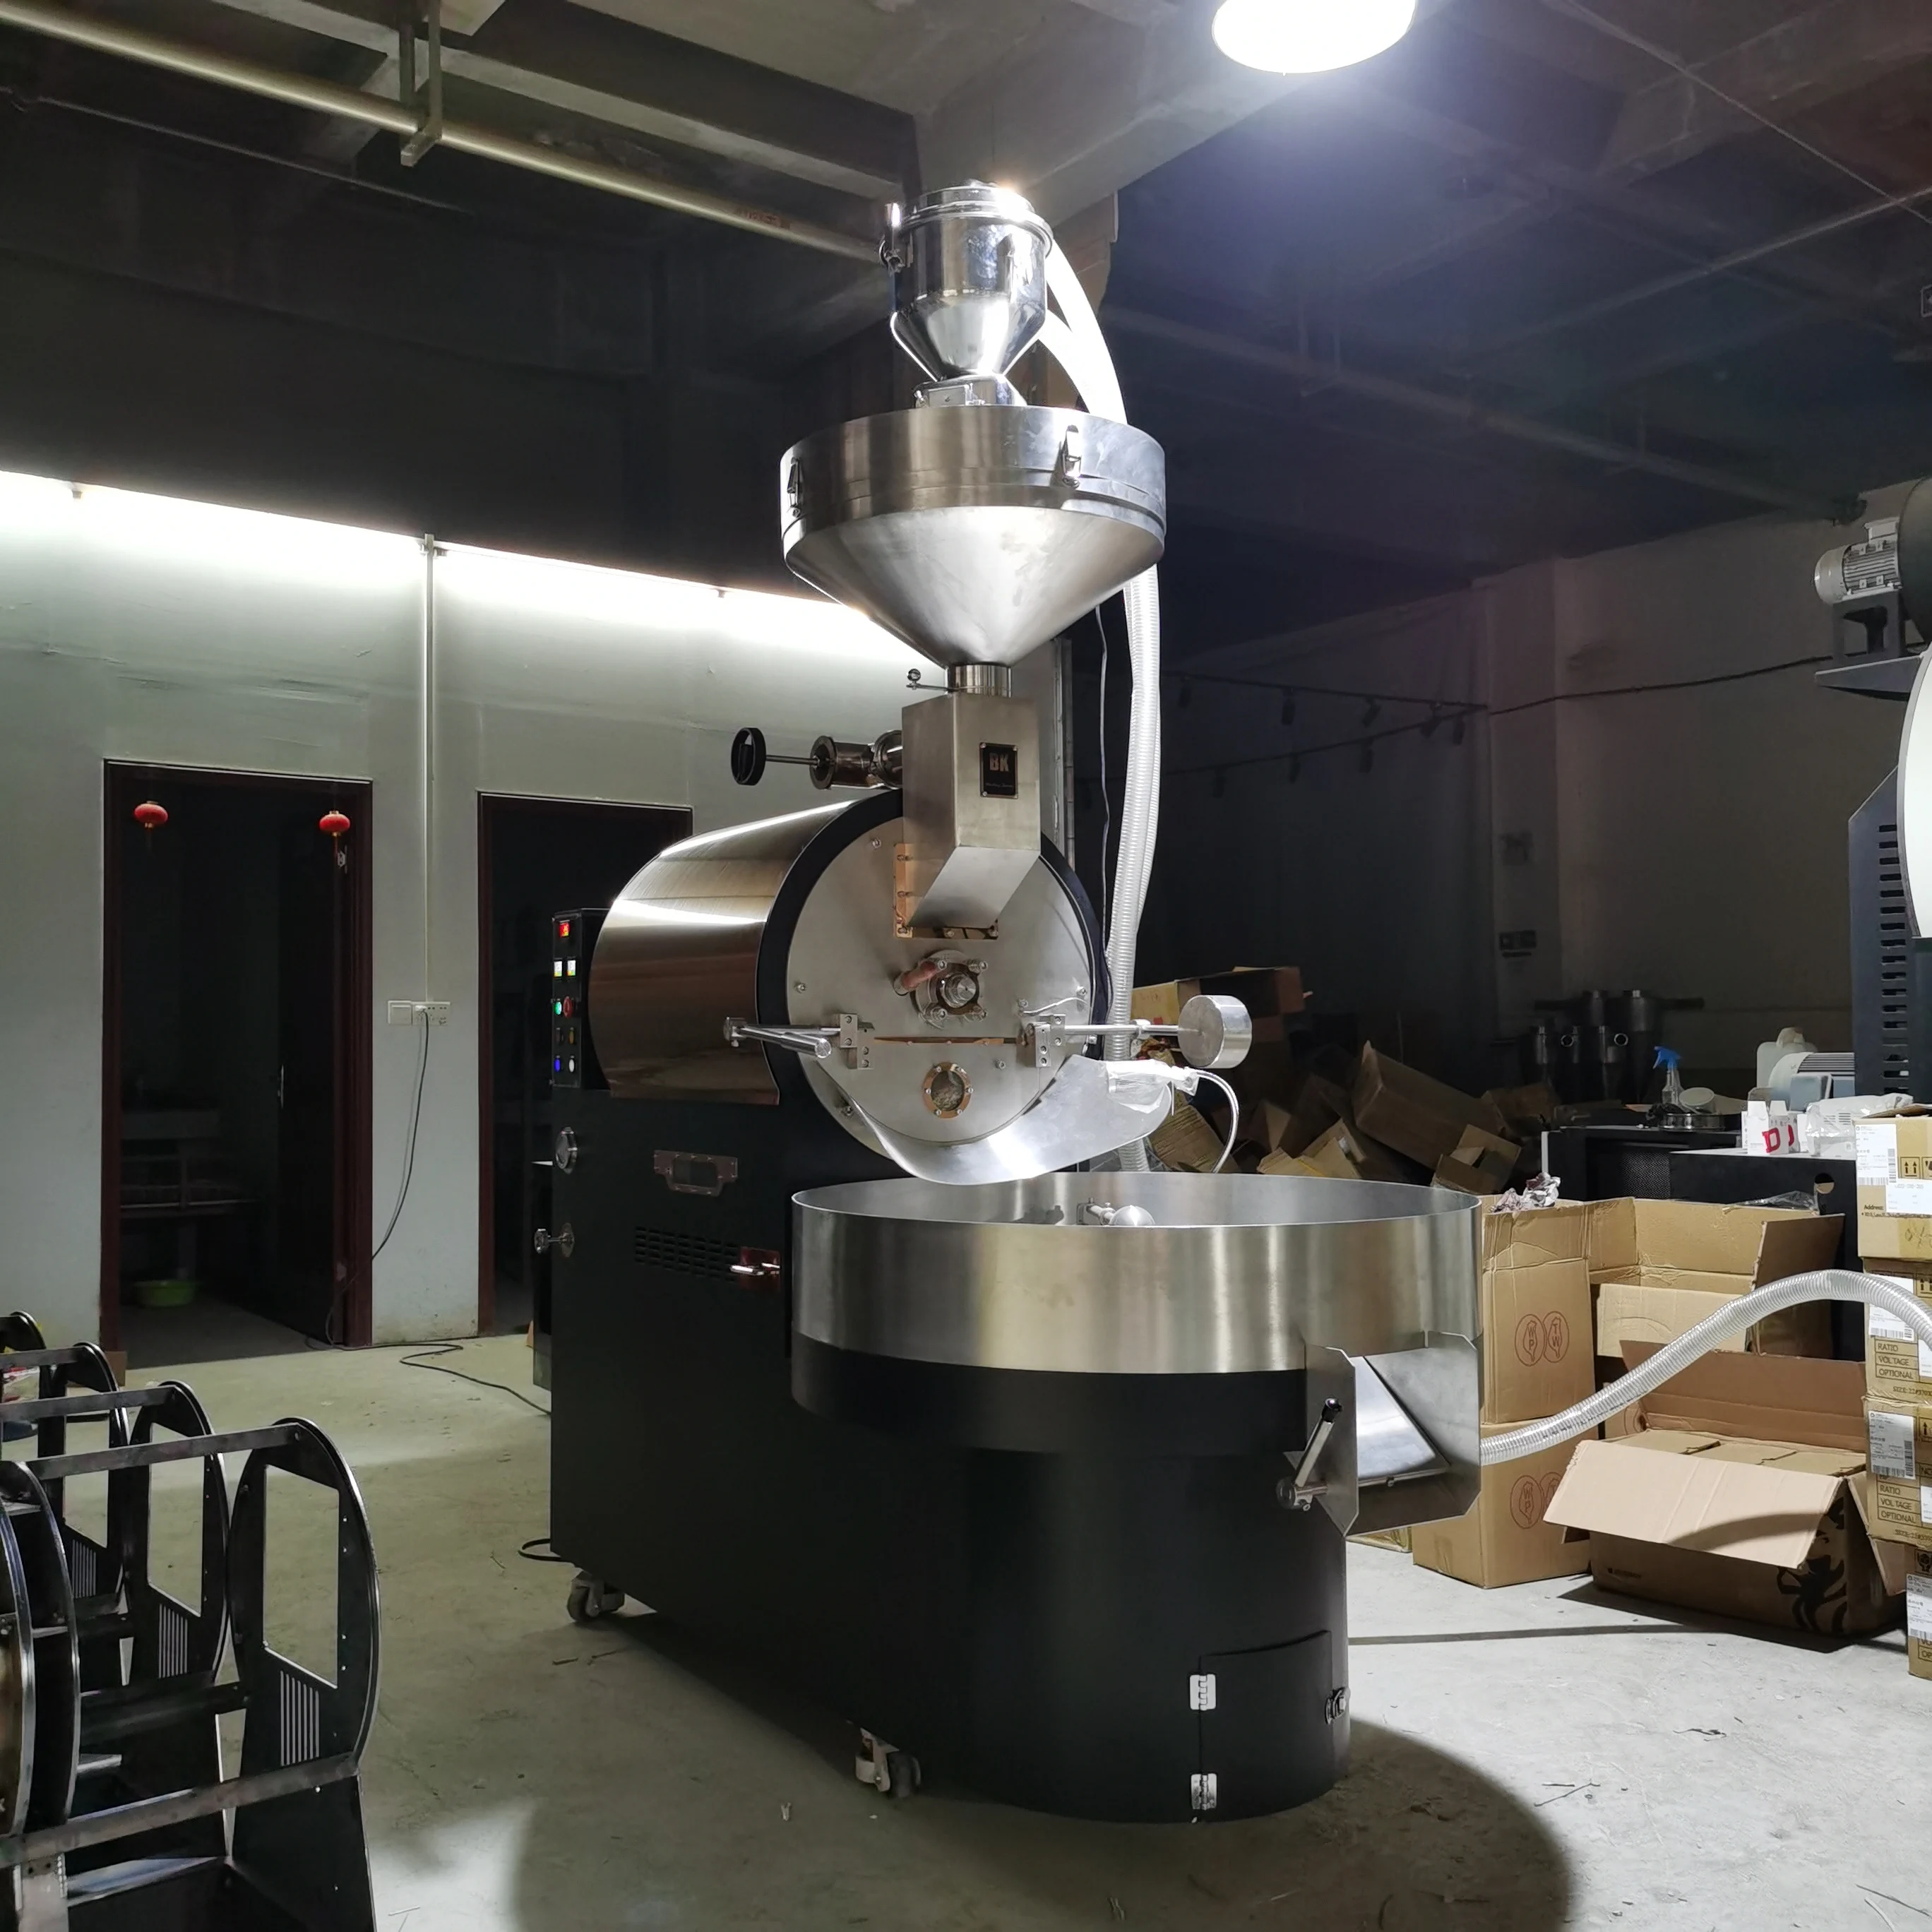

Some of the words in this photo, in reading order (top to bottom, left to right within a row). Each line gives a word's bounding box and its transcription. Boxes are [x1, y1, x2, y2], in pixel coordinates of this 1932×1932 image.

[989, 752, 1010, 772] BK
[1878, 1343, 1899, 1352] RATIO
[1878, 1356, 1910, 1366] VOLTAGE
[1879, 1368, 1914, 1380] OPTIONAL
[1880, 1484, 1901, 1495] RATIO
[1880, 1498, 1913, 1510] VOLTAGE
[1881, 1510, 1916, 1524] OPTIONAL
